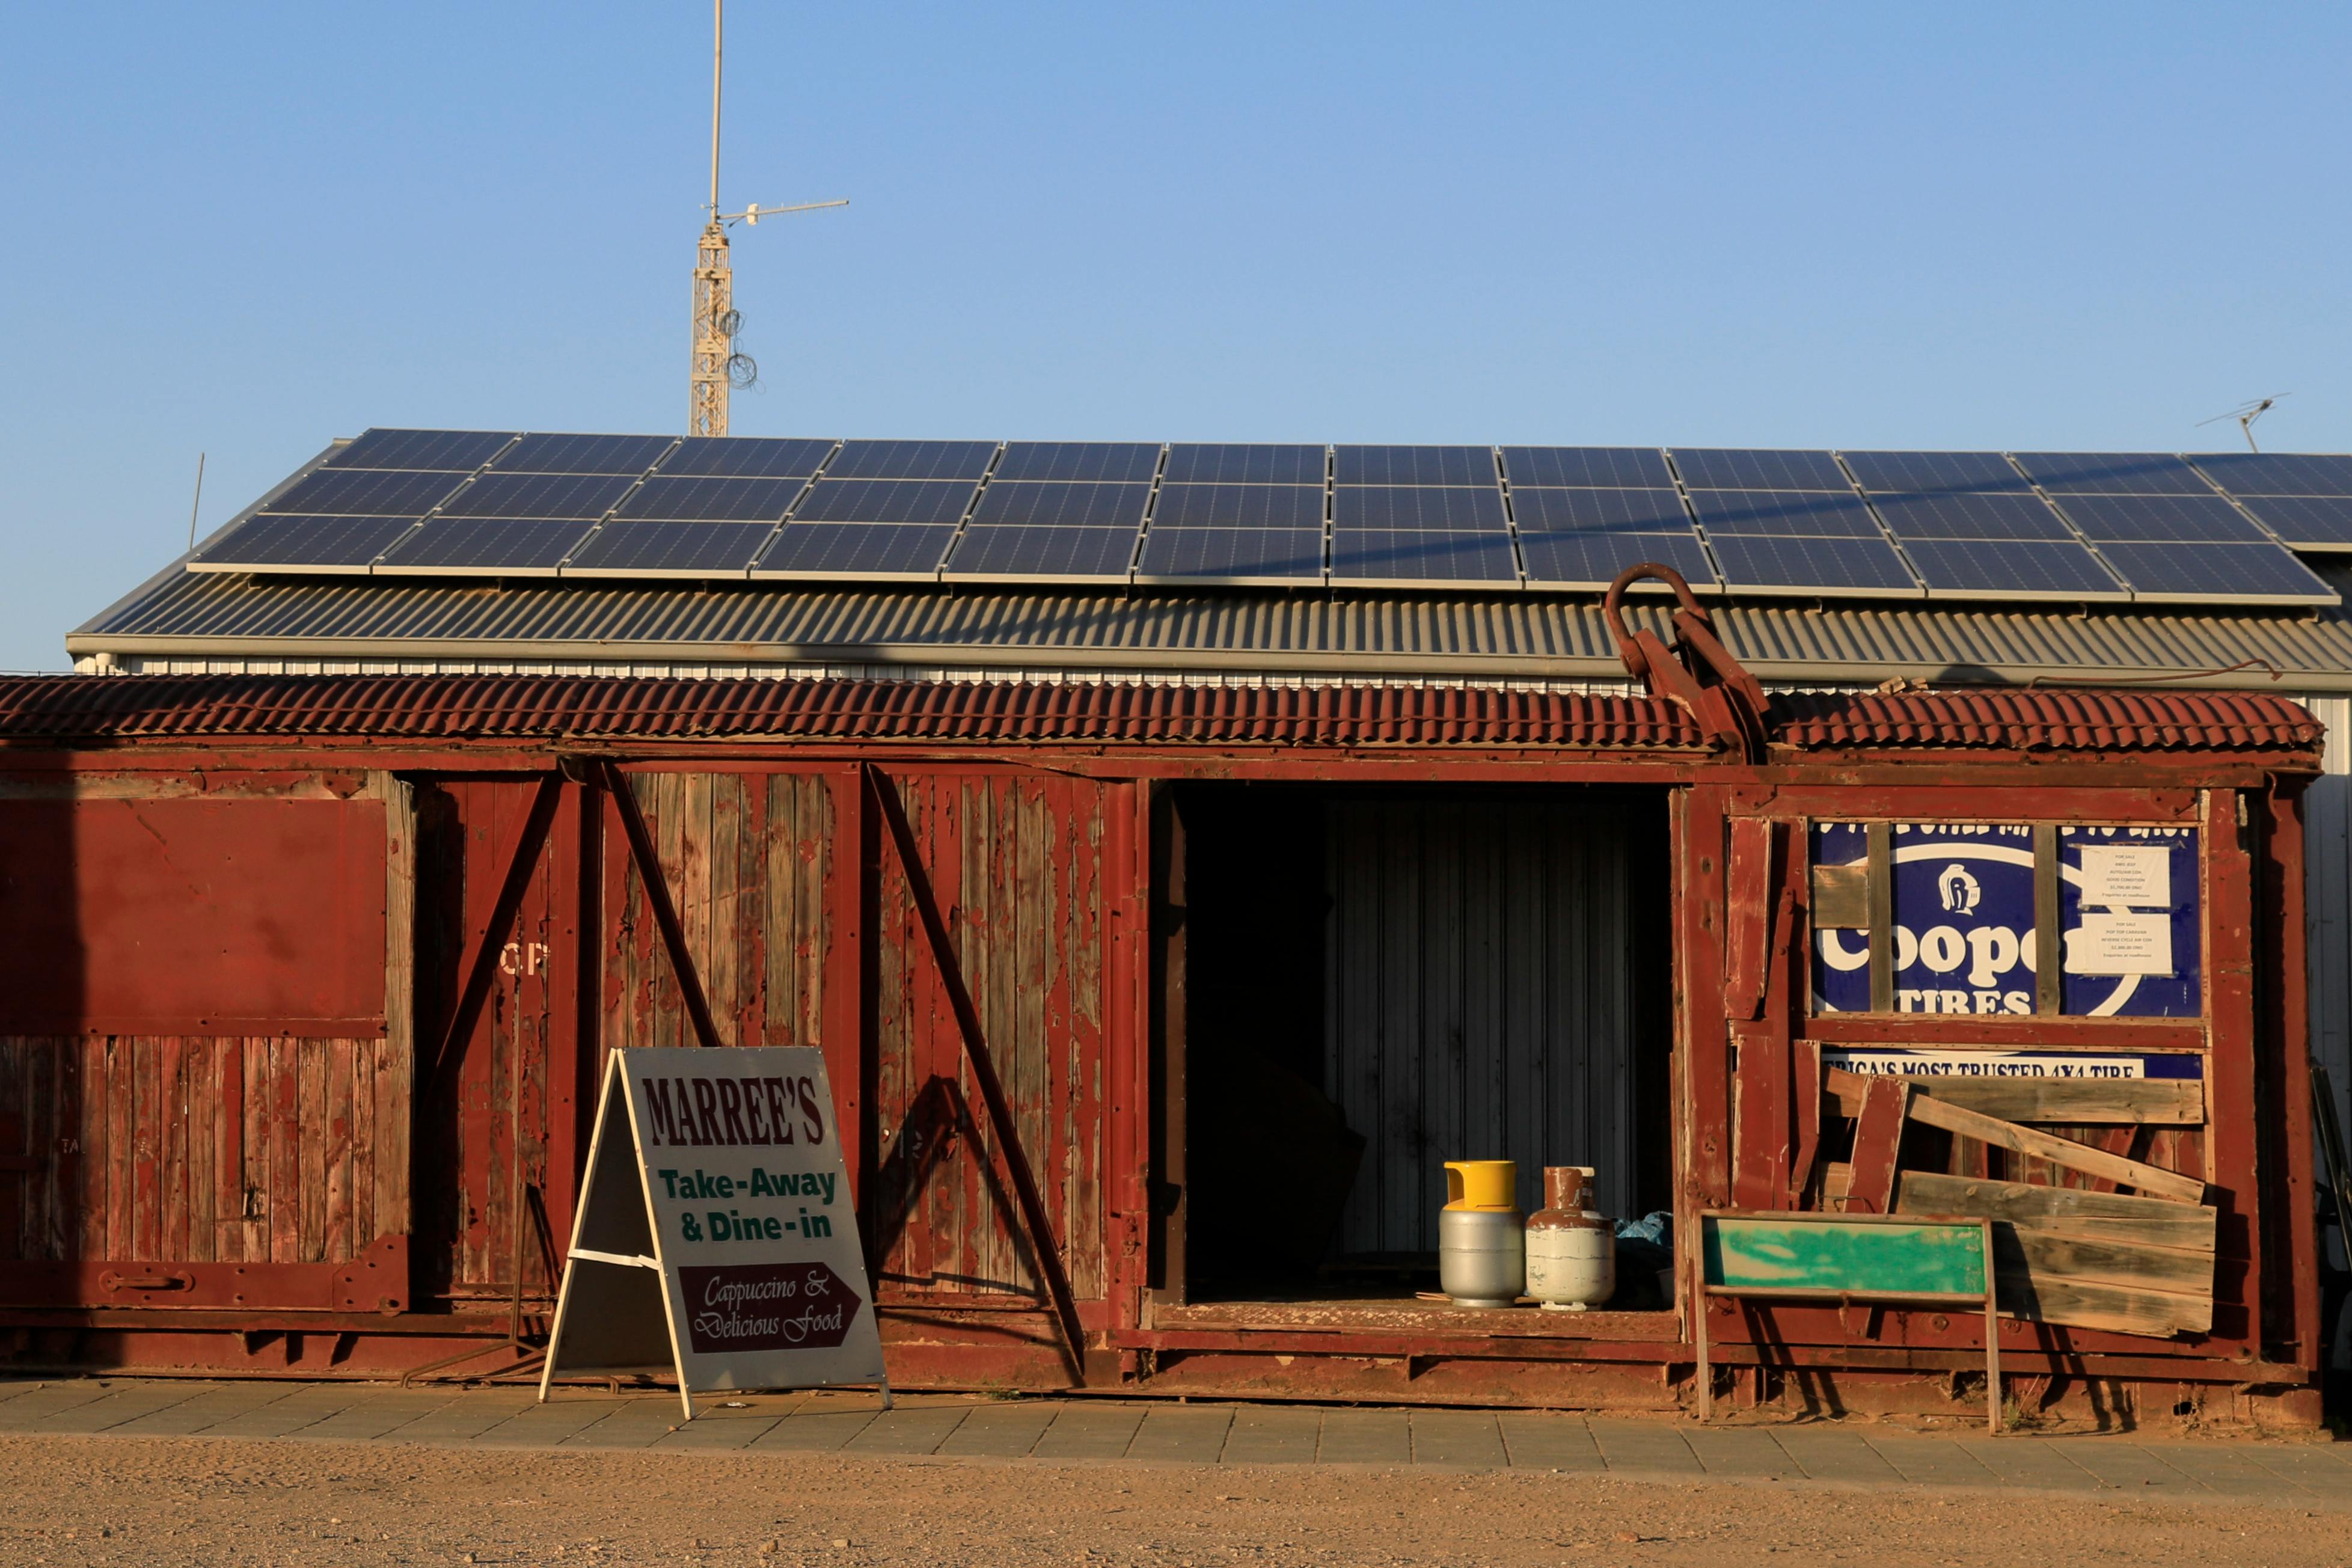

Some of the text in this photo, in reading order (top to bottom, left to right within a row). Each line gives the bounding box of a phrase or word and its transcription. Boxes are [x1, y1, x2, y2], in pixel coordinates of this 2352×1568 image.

[1894, 990, 2031, 1015] TIRES
[1902, 1062, 1952, 1076] MOST
[1958, 1063, 2044, 1077] TRUSTED
[2090, 1065, 2134, 1077] TIRE
[642, 1076, 824, 1146] MARREE'S
[658, 1168, 835, 1205] Take-Away
[681, 1207, 832, 1242] & Dine-in
[705, 1270, 830, 1311] Cappuccino &
[694, 1304, 842, 1342] Delicious Food
